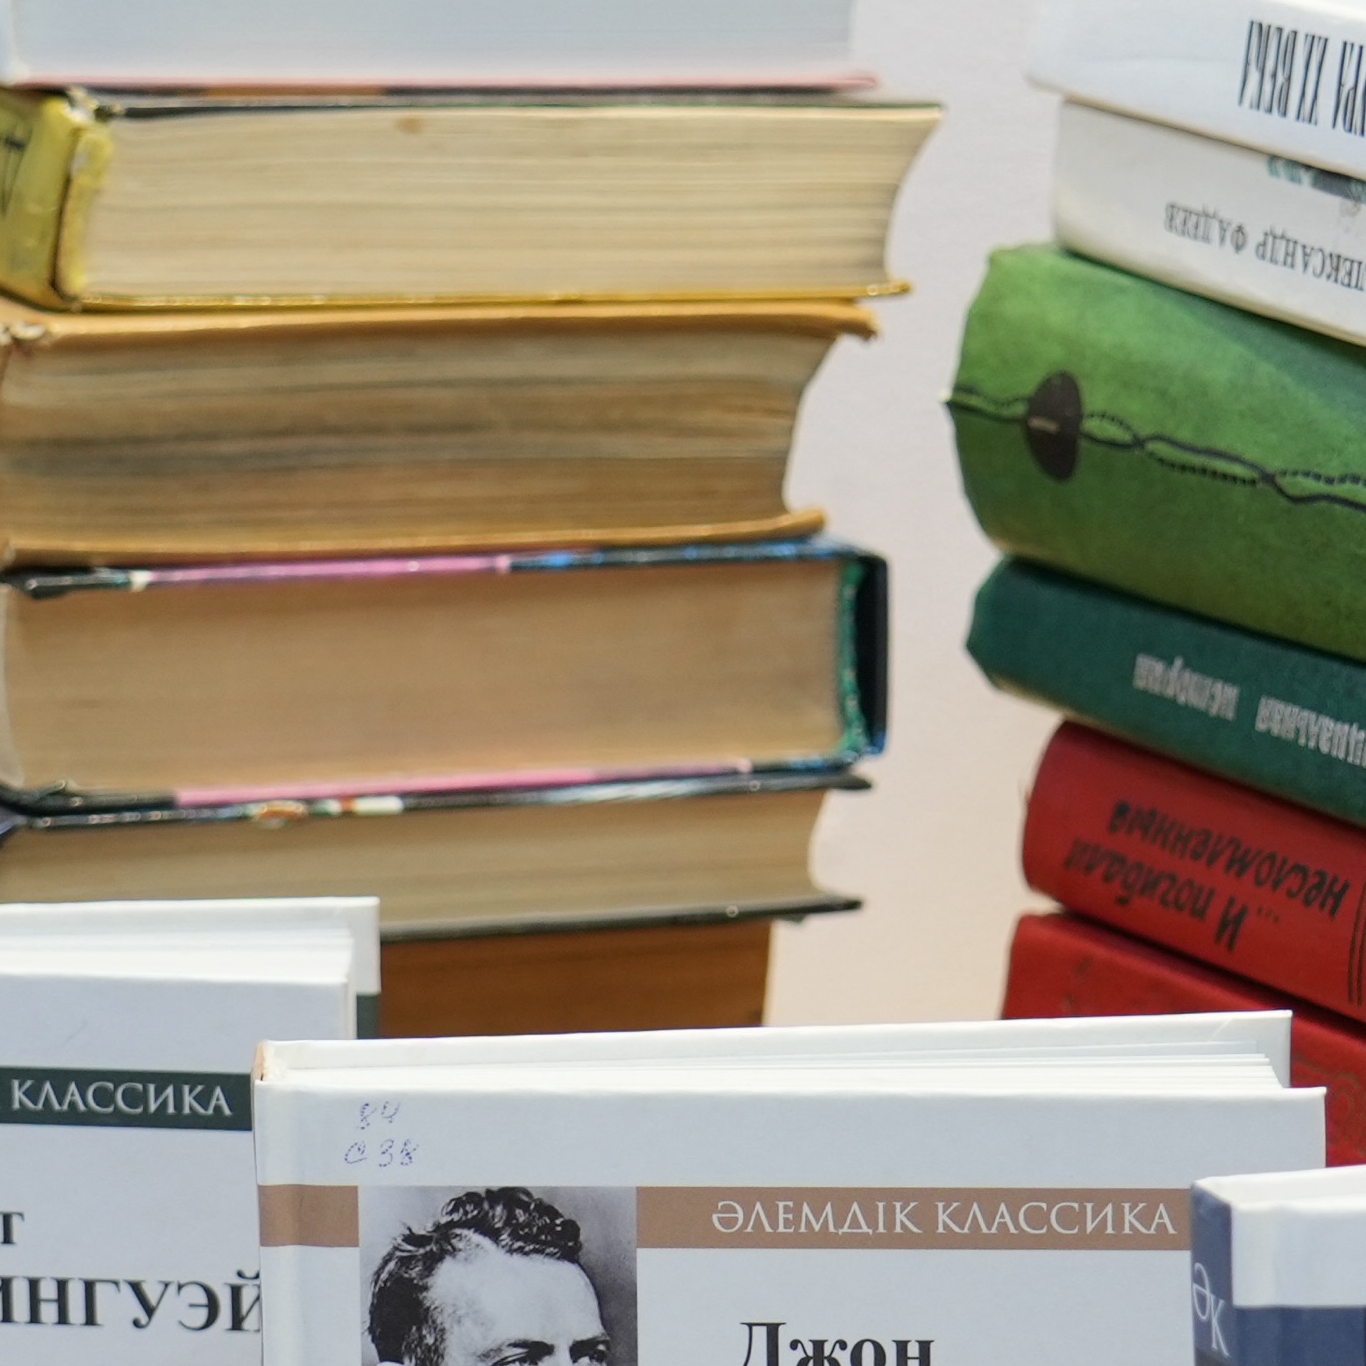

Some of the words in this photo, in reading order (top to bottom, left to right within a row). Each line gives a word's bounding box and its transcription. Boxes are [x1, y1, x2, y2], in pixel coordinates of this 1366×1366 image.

[1236, 17, 1299, 119] ВЕКА
[1162, 202, 1250, 255] ФАДЕЕВ
[1060, 832, 1214, 925] погибали
[1103, 798, 1351, 918] несломленные
[9, 1079, 233, 1118] КЛАССИКА
[711, 1199, 924, 1236] ӘЛЕМДІК
[935, 1200, 1179, 1236] КЛАССИКА
[1192, 1261, 1230, 1358] ӘК
